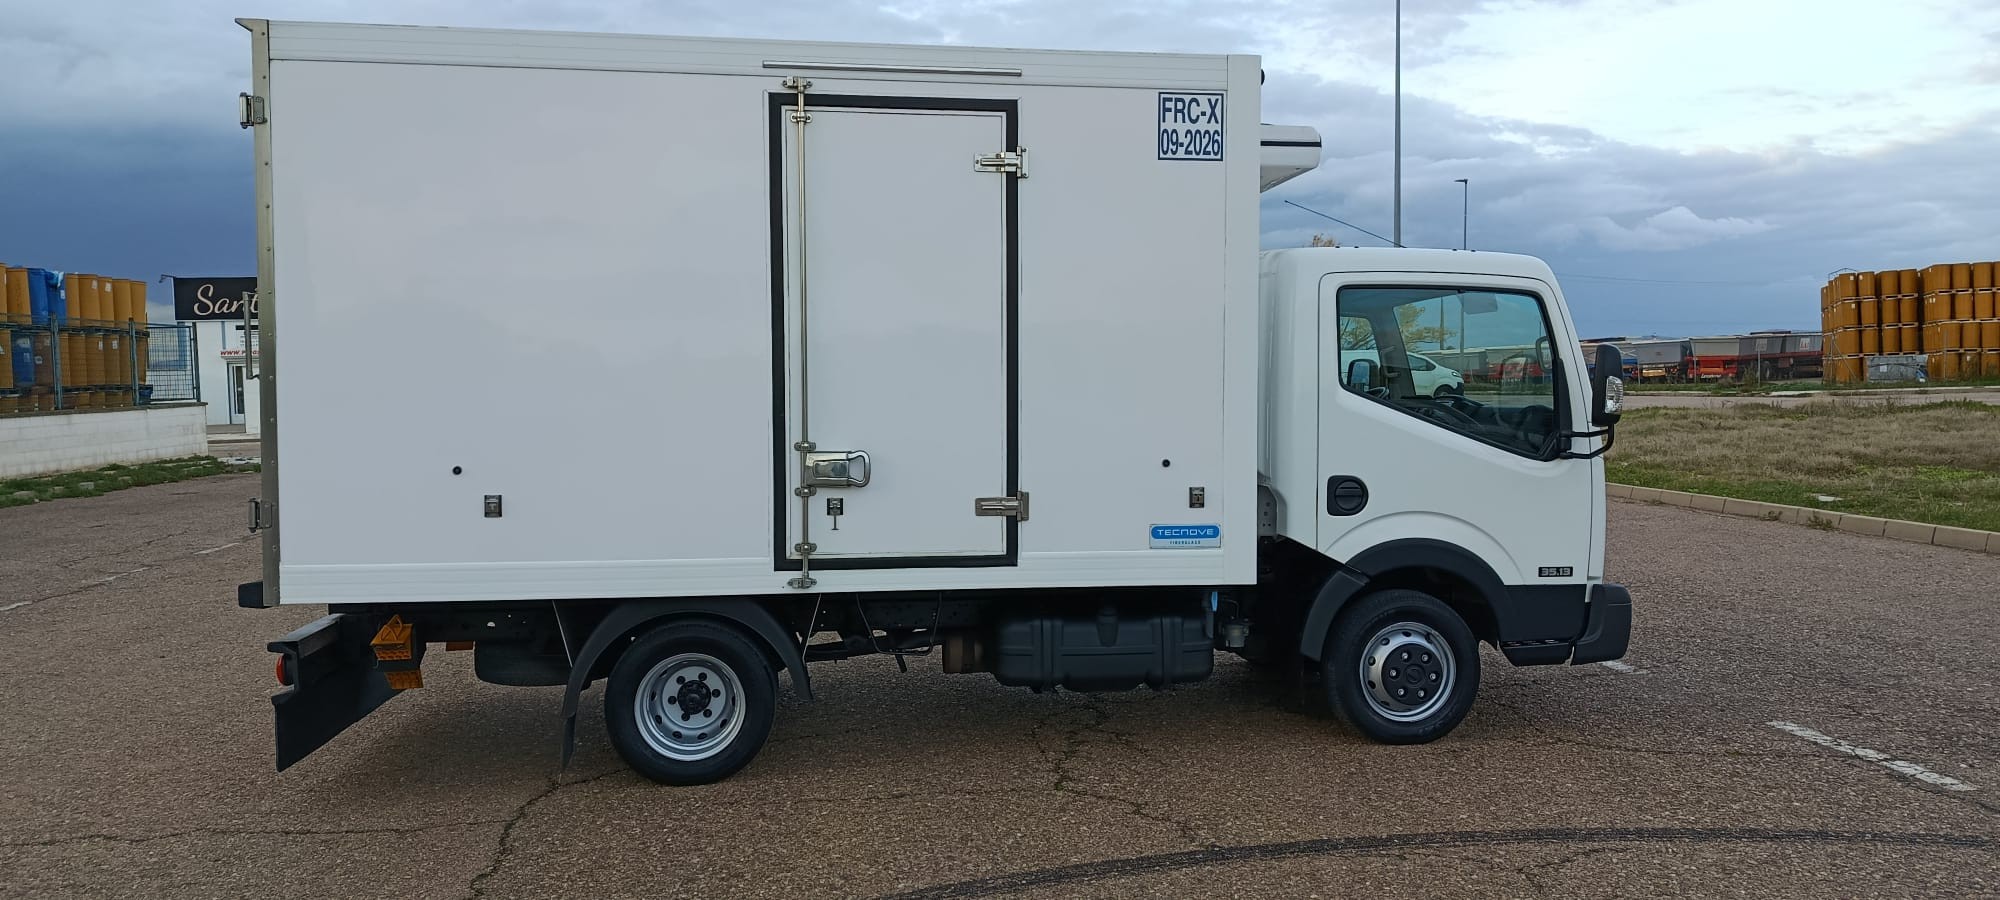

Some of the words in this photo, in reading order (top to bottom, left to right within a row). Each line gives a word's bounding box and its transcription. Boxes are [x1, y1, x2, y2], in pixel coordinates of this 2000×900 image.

[1161, 97, 1220, 124] FRC-X
[1160, 128, 1221, 156] 09-2026
[1156, 528, 1214, 536] TECNOVE
[1541, 567, 1571, 576] 35.13
